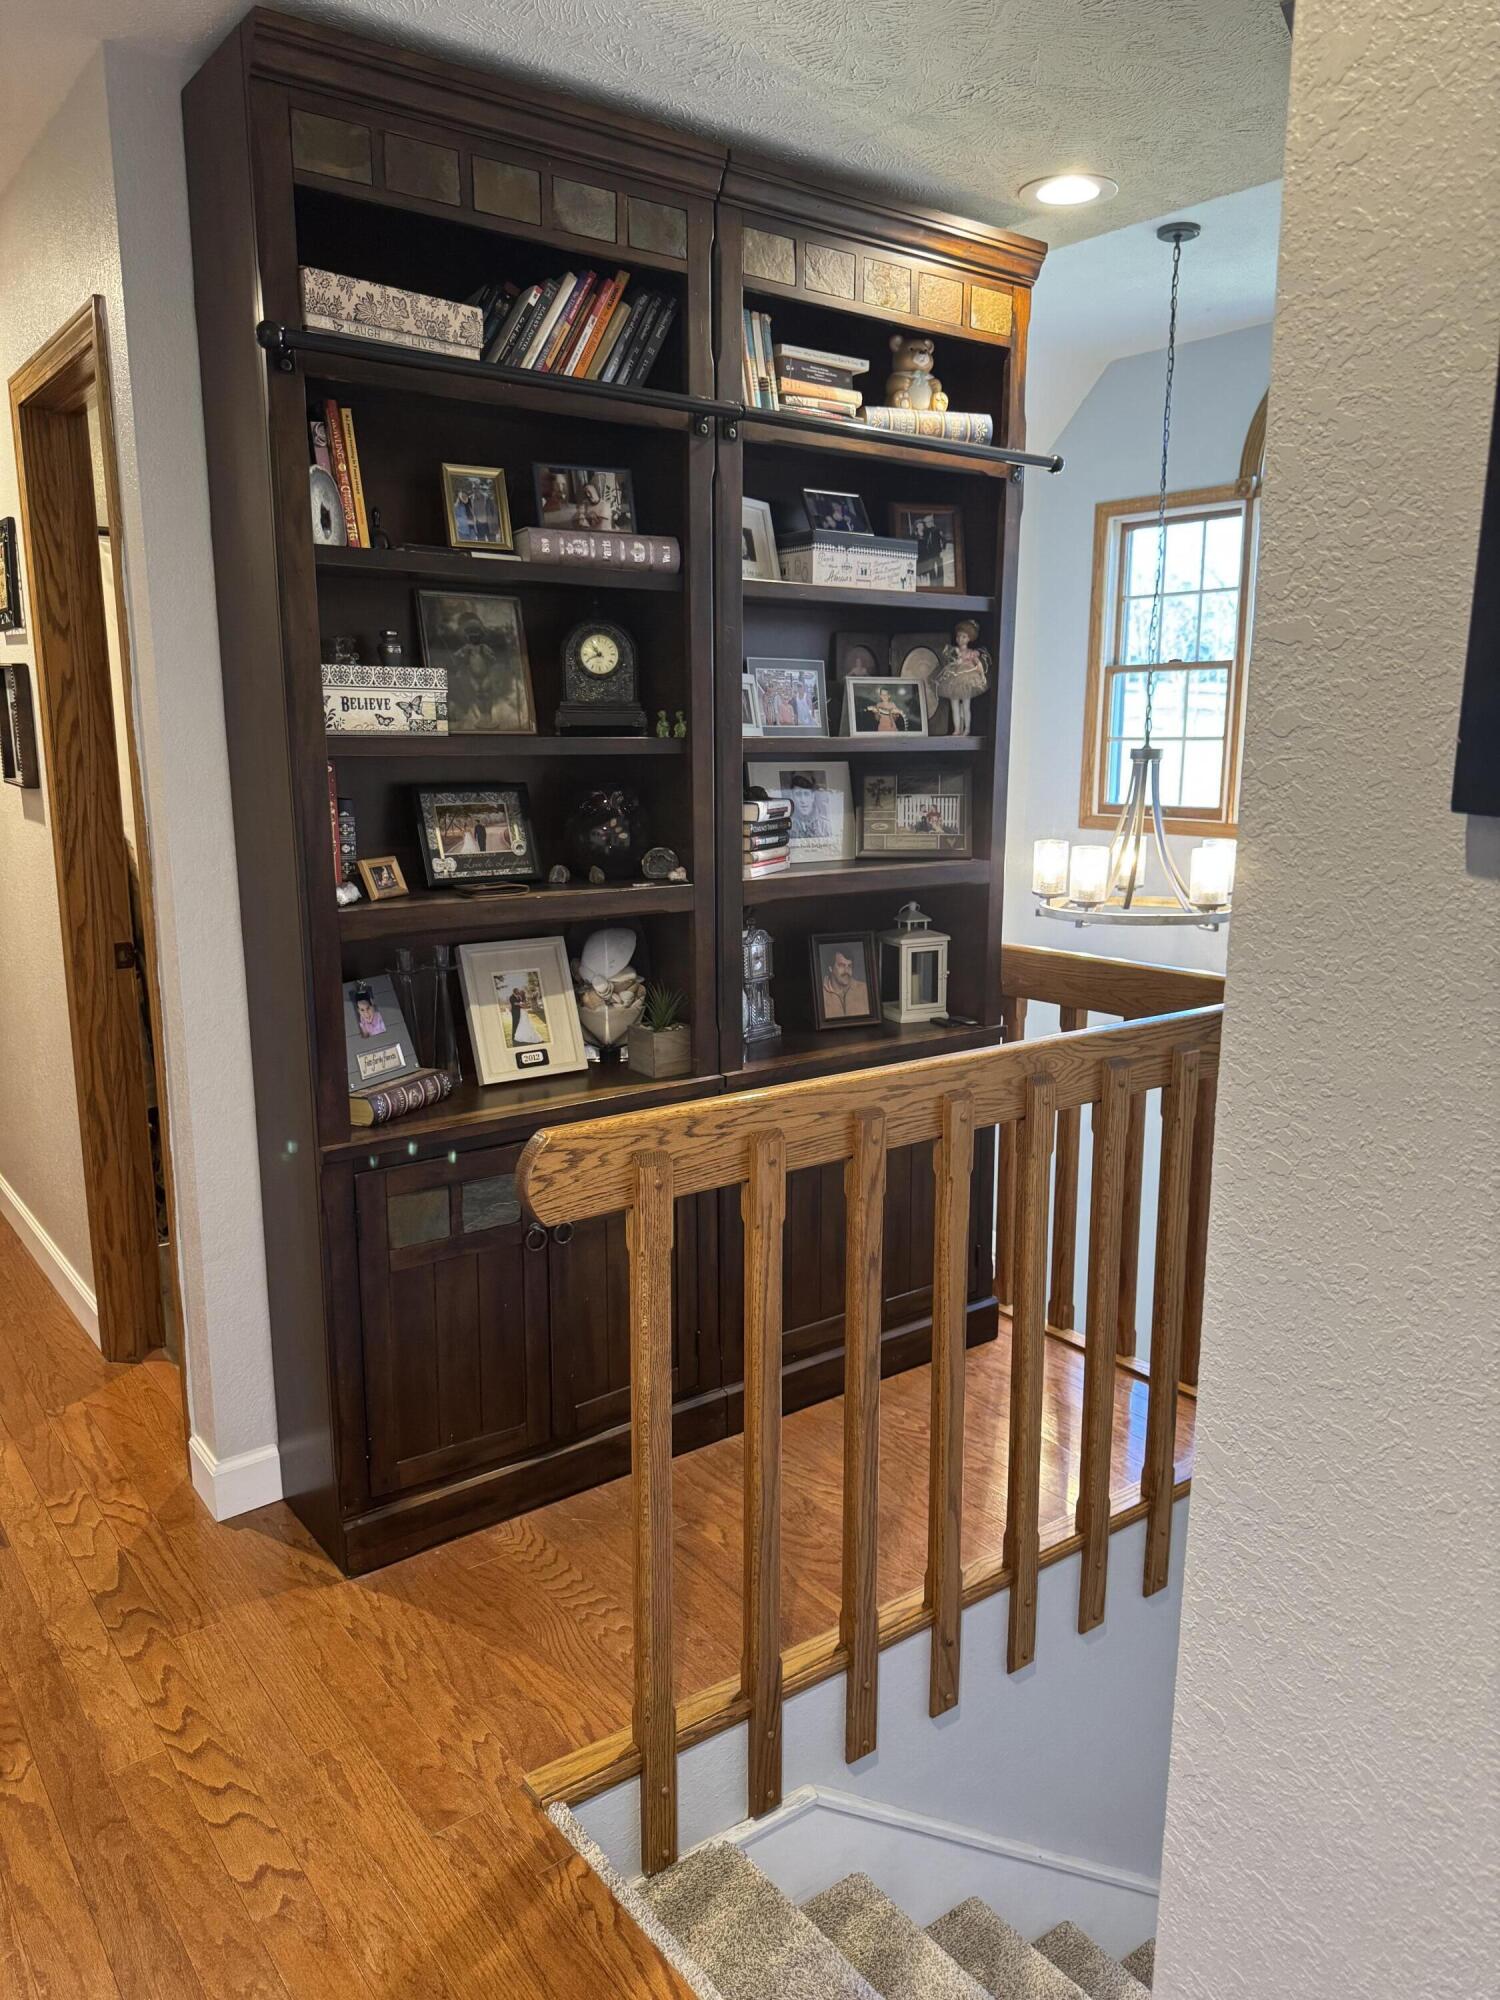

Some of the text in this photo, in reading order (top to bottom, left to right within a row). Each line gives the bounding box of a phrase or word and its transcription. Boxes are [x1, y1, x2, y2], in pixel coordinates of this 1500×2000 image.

[536, 304, 547, 329] HARRY
[349, 324, 435, 351] LAUGH LIVE
[523, 328, 535, 351] POTTER
[347, 521, 358, 540] PIG
[340, 695, 391, 712] BELIEVE
[523, 1053, 541, 1062] 2012
